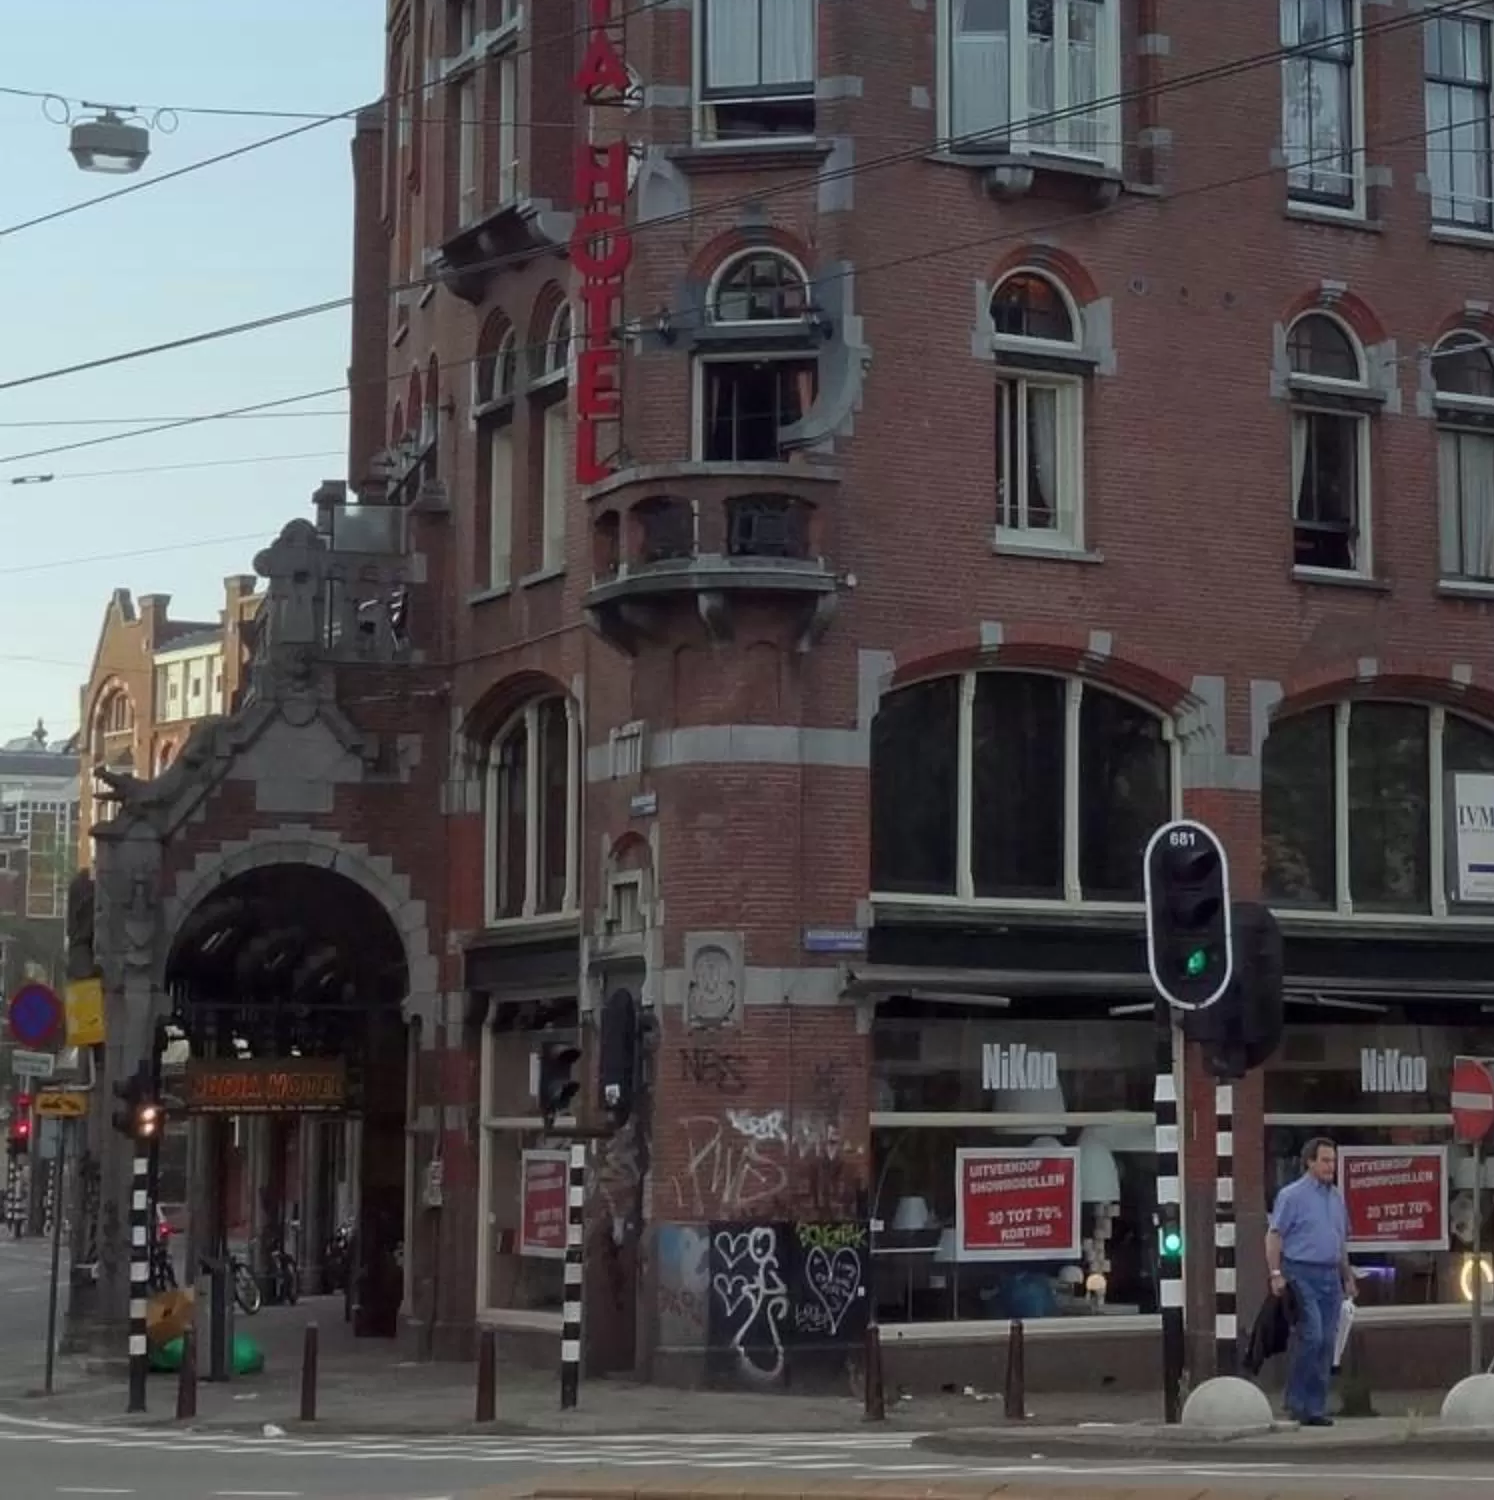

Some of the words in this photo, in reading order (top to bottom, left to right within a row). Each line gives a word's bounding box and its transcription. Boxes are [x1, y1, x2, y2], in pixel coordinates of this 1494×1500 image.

[570, 138, 633, 486] HOTEL
[1169, 831, 1196, 847] 681
[1006, 1207, 1032, 1223] TOT
[1036, 1204, 1063, 1220] 70%
